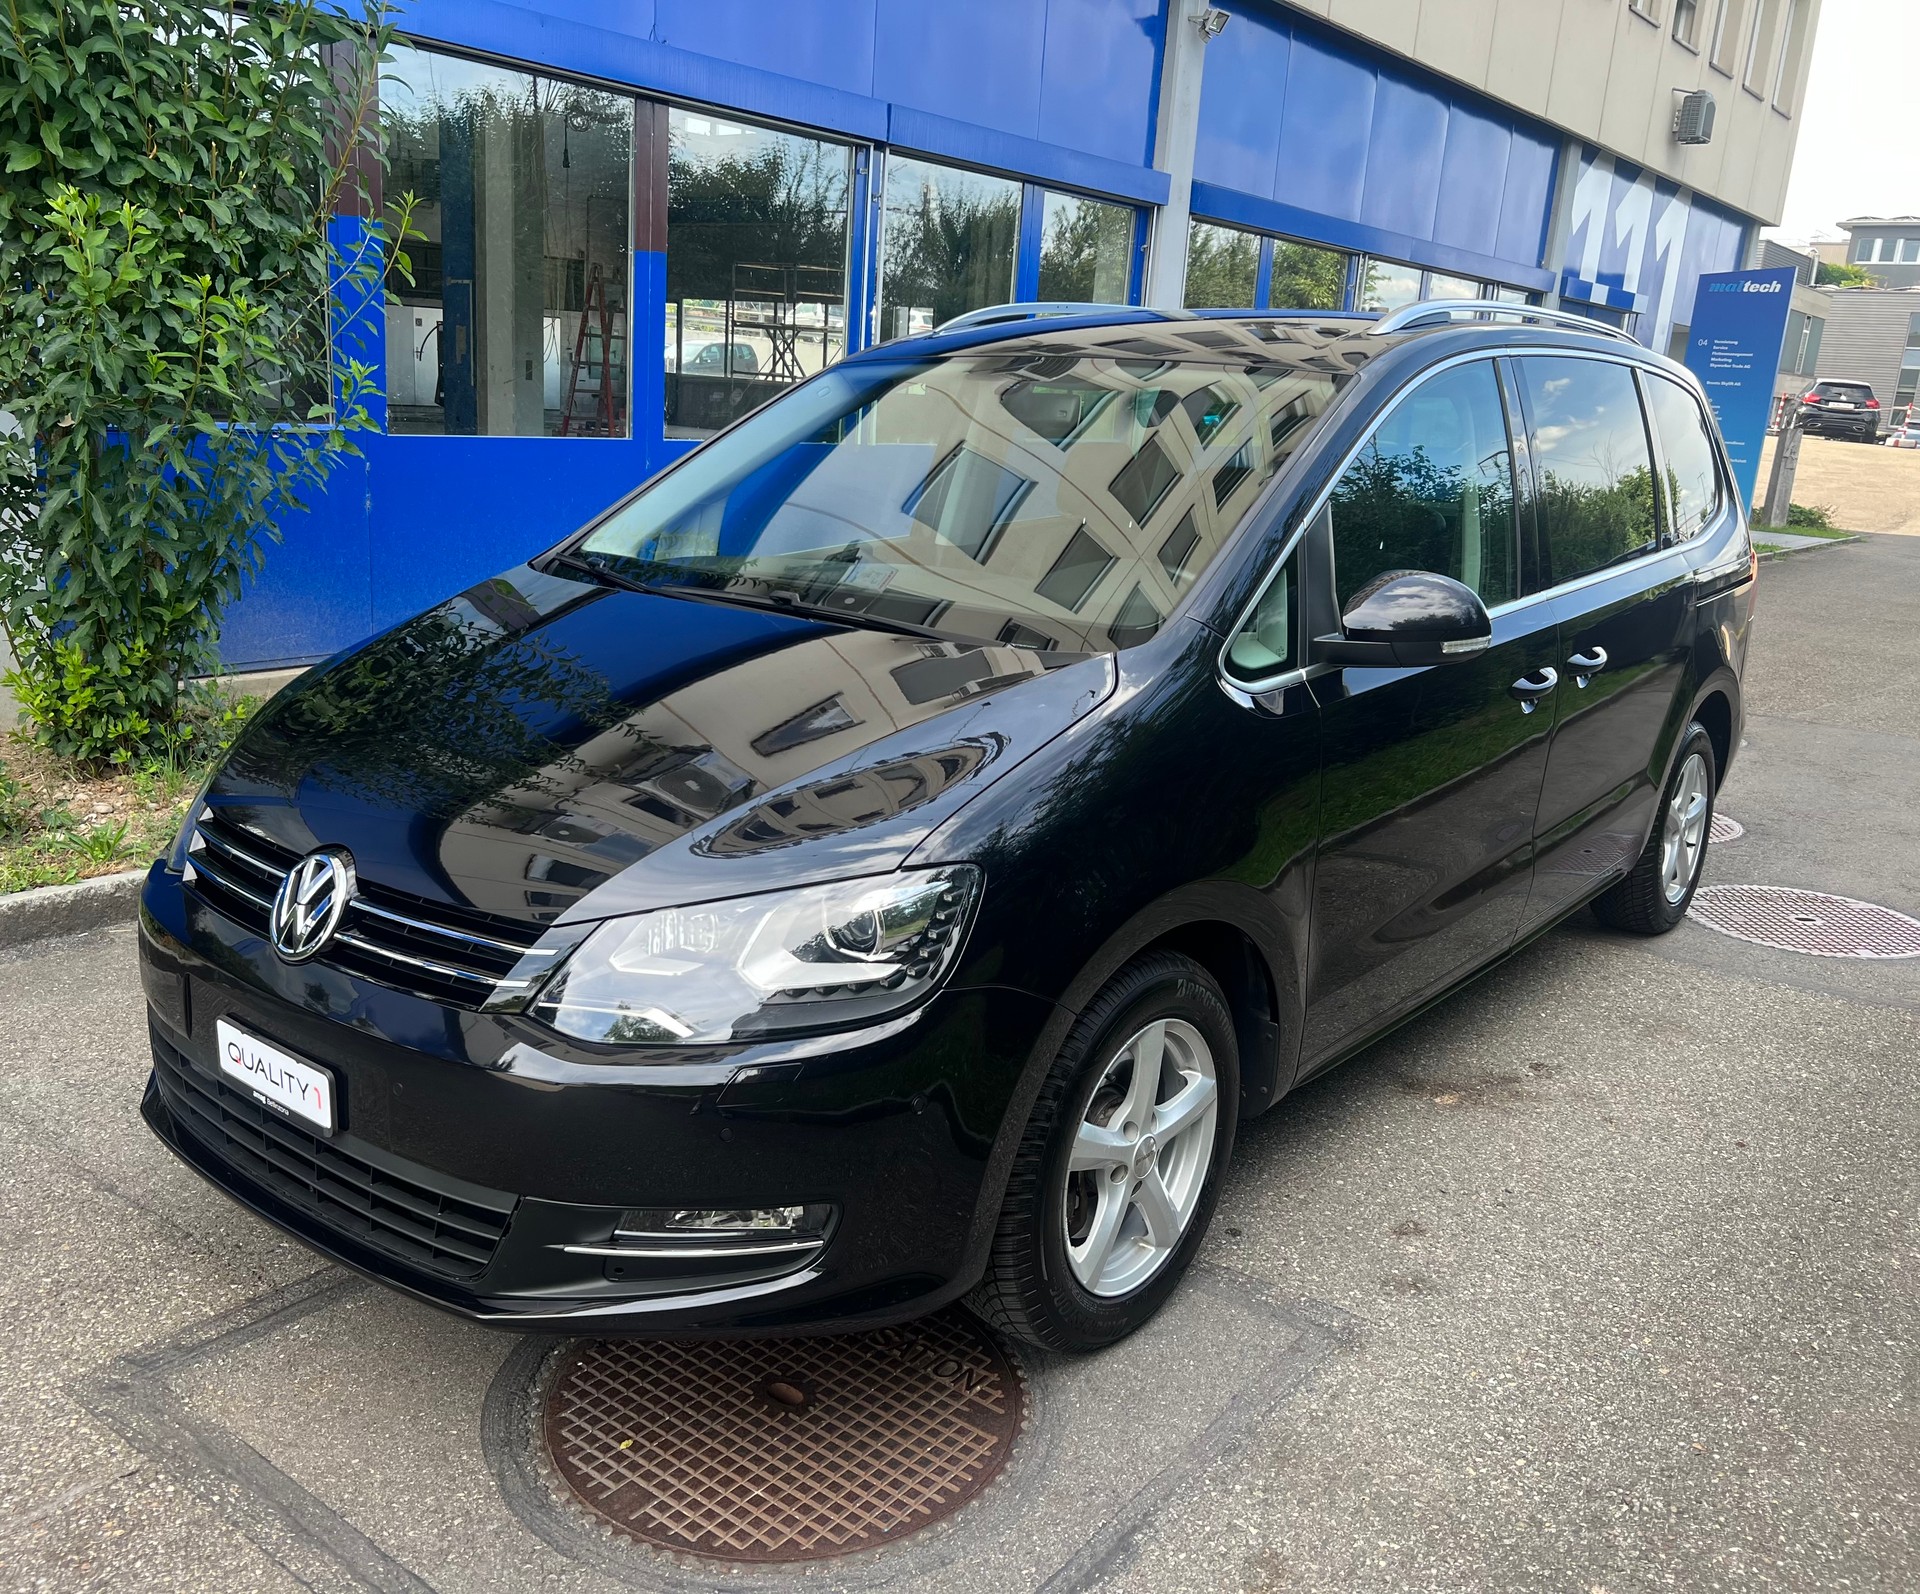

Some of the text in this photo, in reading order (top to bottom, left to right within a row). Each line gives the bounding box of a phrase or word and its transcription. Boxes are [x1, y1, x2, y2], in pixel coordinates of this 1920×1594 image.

[1708, 280, 1782, 293] maltech
[1697, 339, 1708, 347] 04
[227, 1041, 310, 1101] QUALITY
